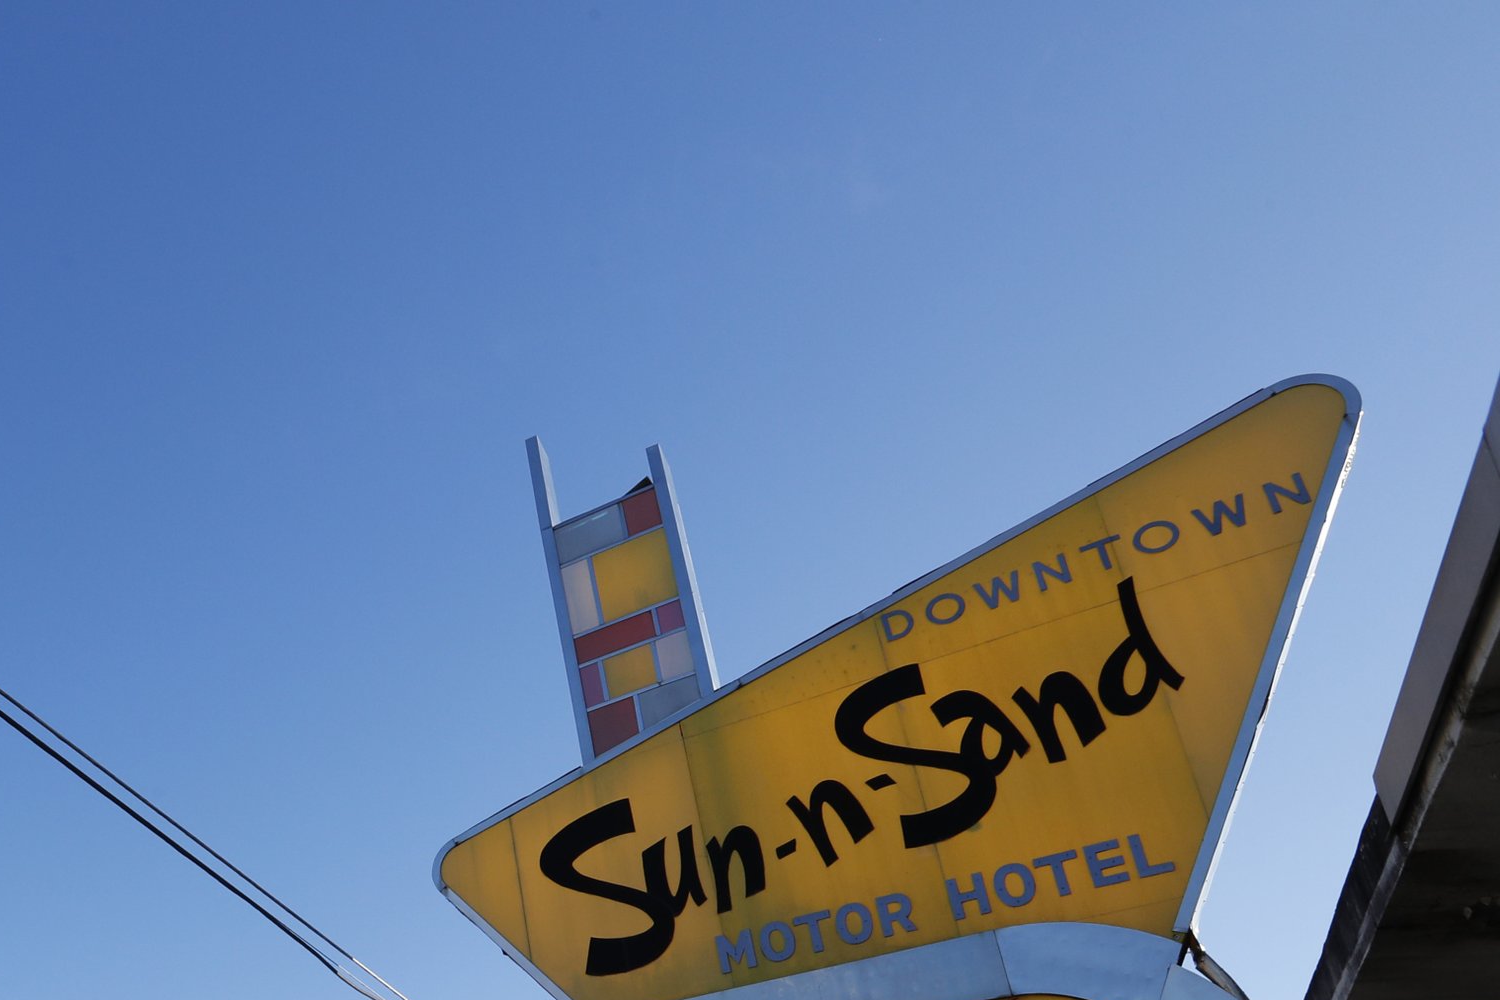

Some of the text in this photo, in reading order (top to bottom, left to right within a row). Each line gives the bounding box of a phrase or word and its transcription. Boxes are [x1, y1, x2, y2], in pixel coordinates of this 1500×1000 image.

[880, 471, 1313, 643] DOWNTOWN
[539, 575, 1186, 977] Sun-n-Sand
[714, 834, 1176, 975] MOTOR HOTEL
